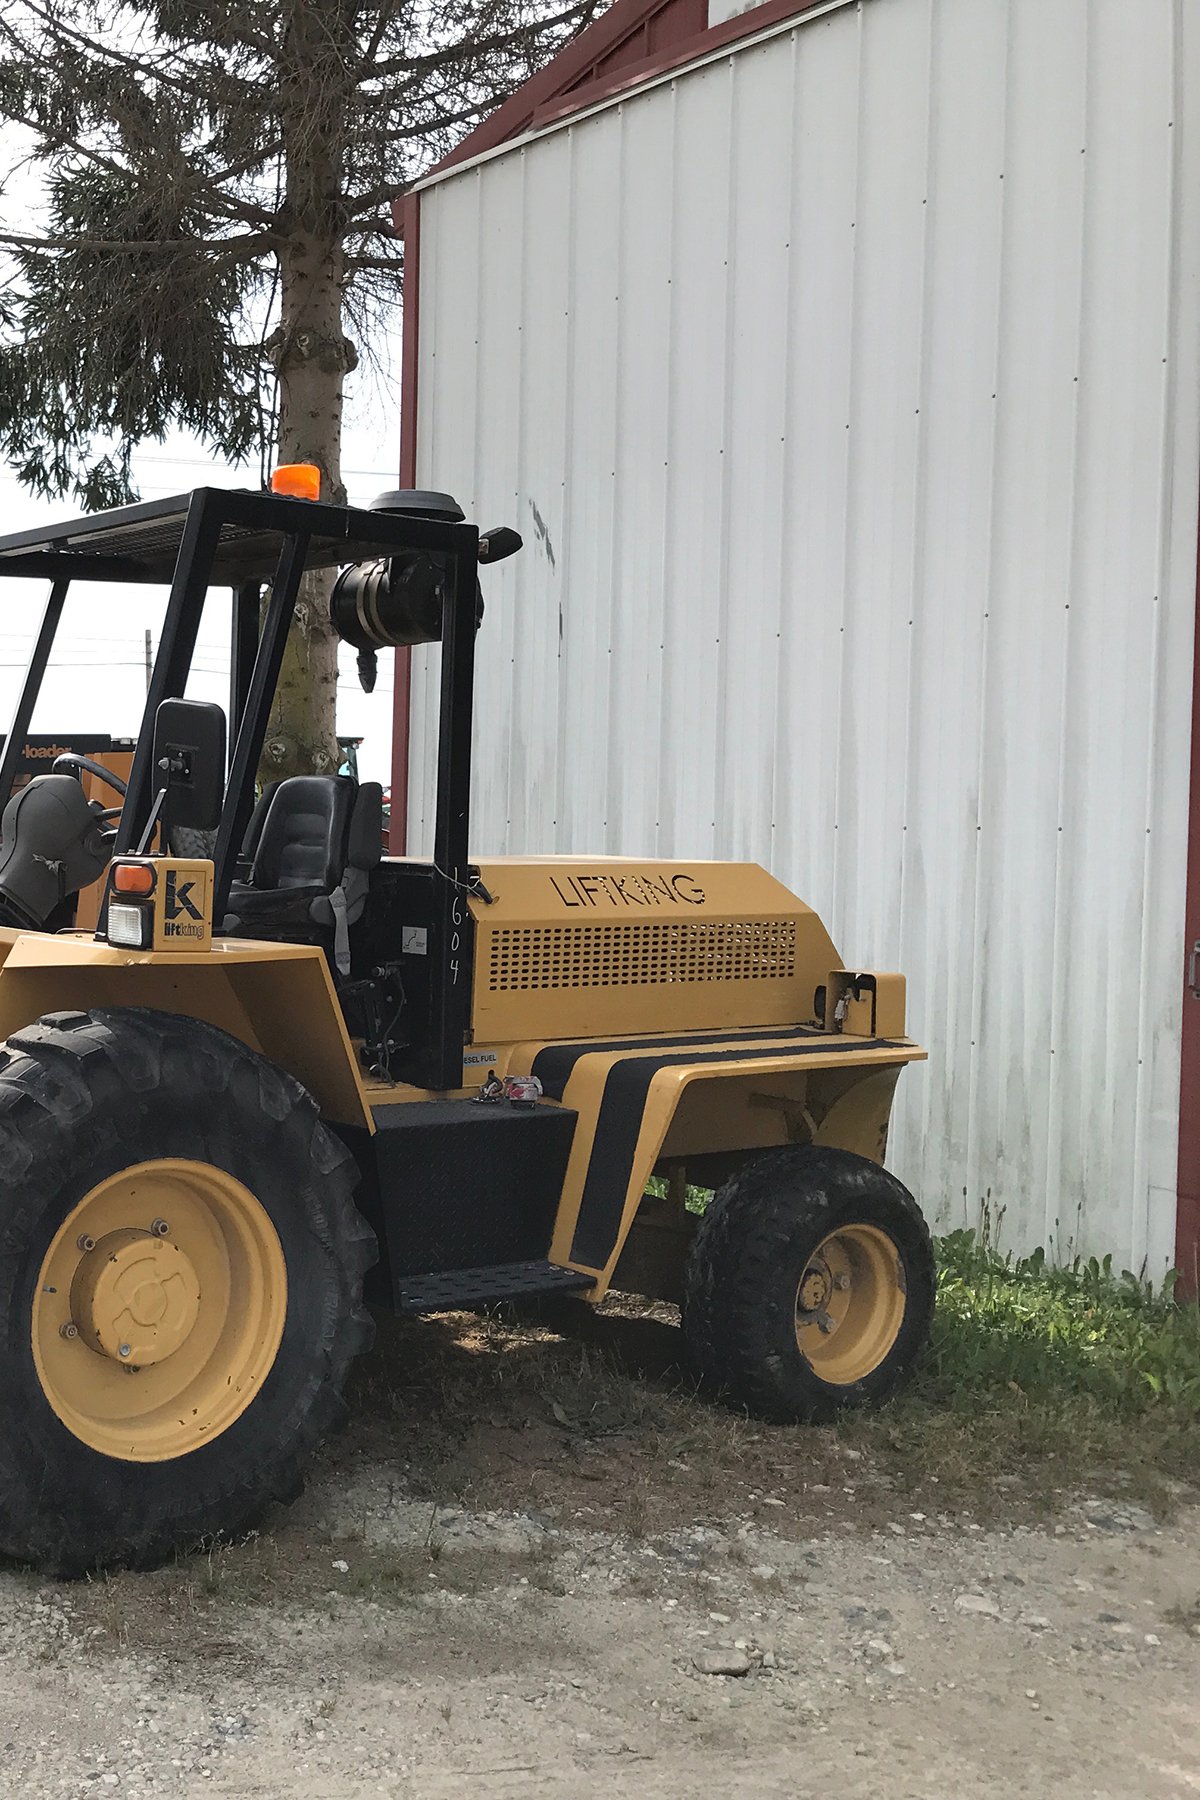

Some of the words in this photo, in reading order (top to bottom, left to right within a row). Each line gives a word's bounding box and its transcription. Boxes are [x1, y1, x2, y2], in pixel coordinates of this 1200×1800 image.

[549, 874, 706, 906] LIFTKING
[164, 922, 205, 941] liftking
[464, 1056, 480, 1065] ESEL
[480, 1054, 497, 1062] FUEL
